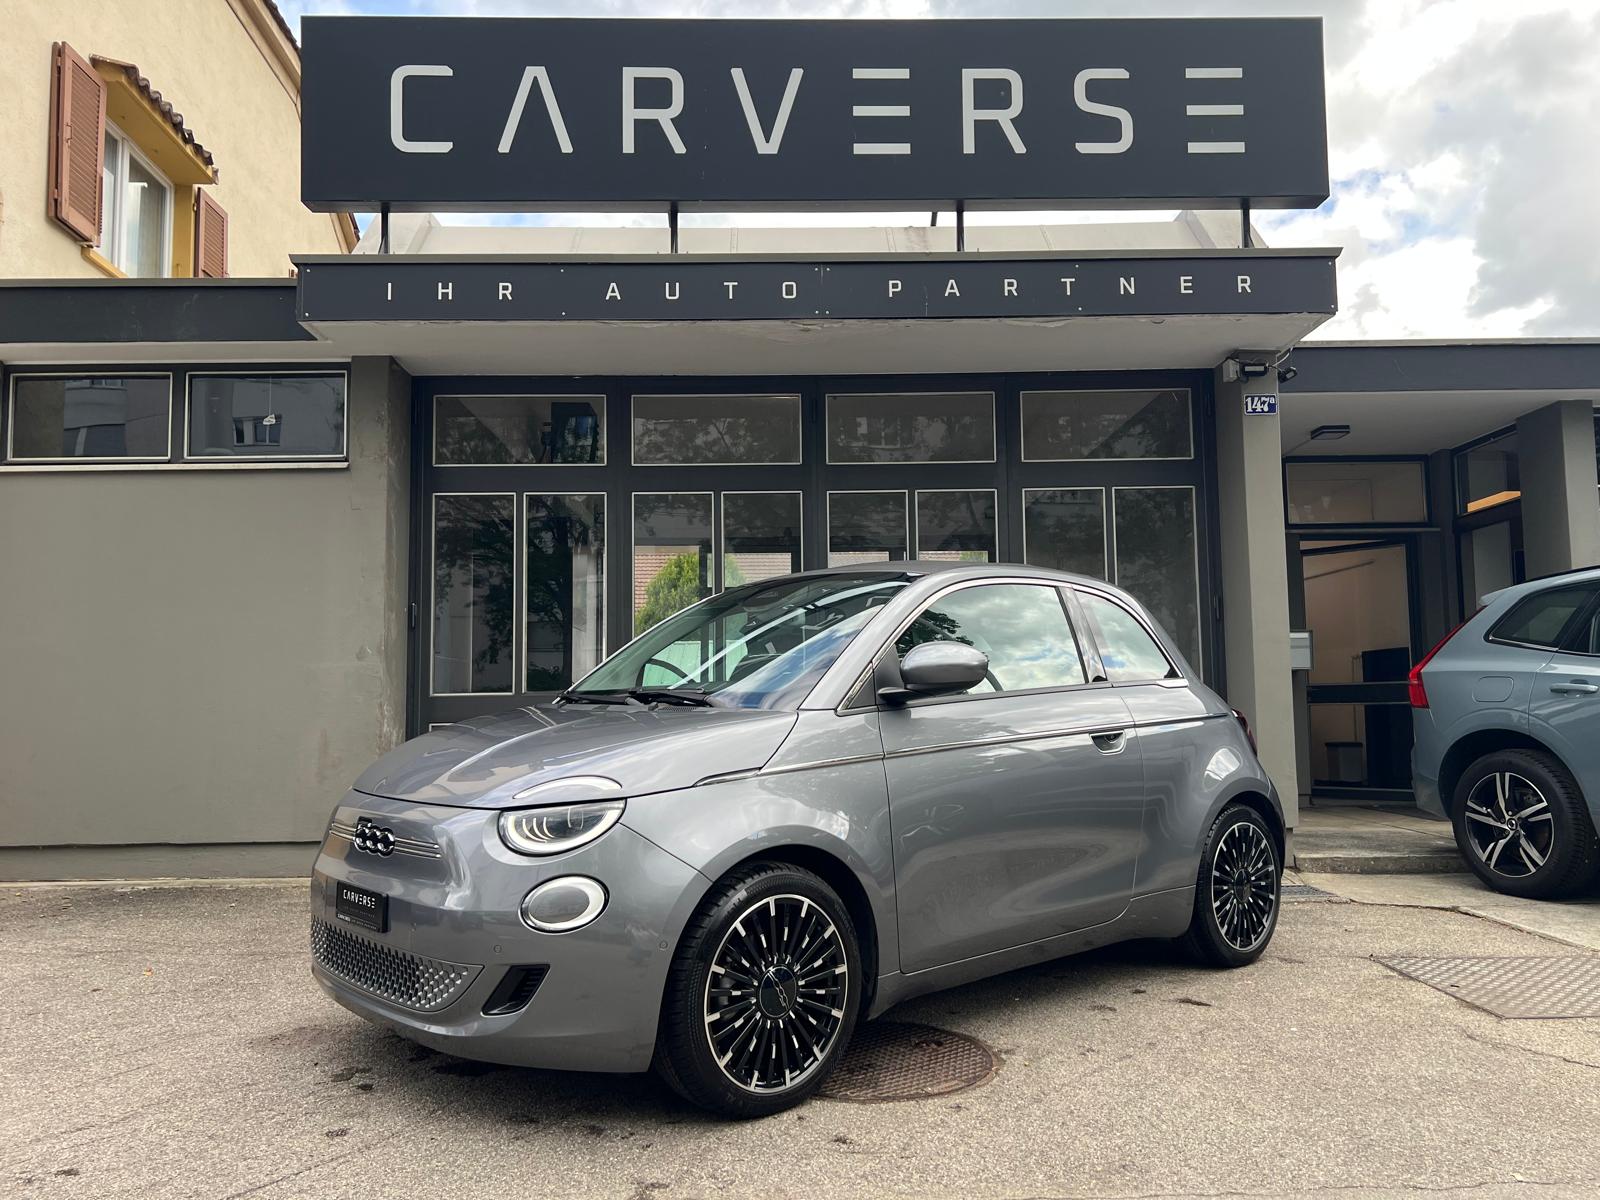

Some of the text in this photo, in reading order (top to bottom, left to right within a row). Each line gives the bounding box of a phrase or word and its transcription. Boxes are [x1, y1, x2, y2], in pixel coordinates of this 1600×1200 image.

[390, 64, 1246, 155] CARVERSE
[387, 275, 1253, 301] IHR AUTO PARTNER
[343, 889, 376, 909] CARVERSE
